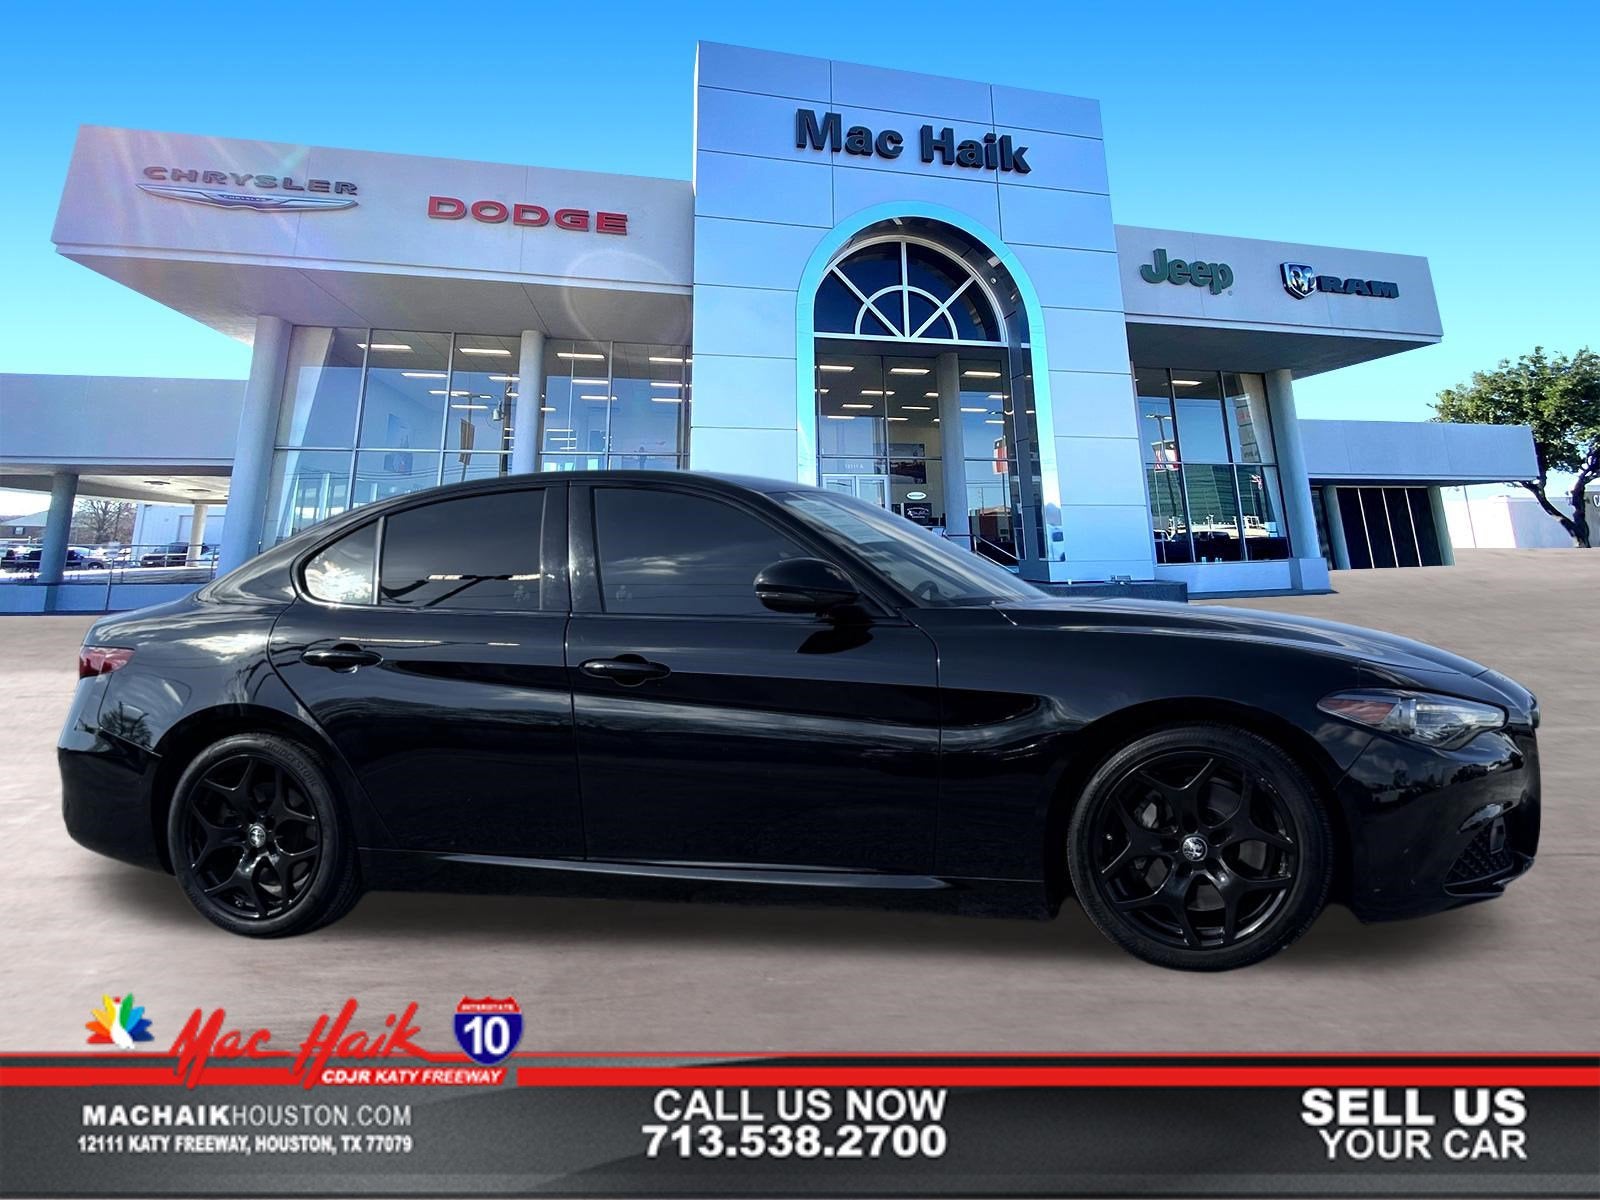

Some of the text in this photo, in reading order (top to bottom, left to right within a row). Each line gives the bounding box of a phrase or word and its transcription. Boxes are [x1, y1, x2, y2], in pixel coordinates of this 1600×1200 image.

[796, 108, 1032, 174] Mac Haik
[143, 166, 358, 196] CHRYSLER
[428, 195, 627, 236] DODGE
[1140, 248, 1234, 295] Jeep
[1315, 275, 1399, 299] RAM
